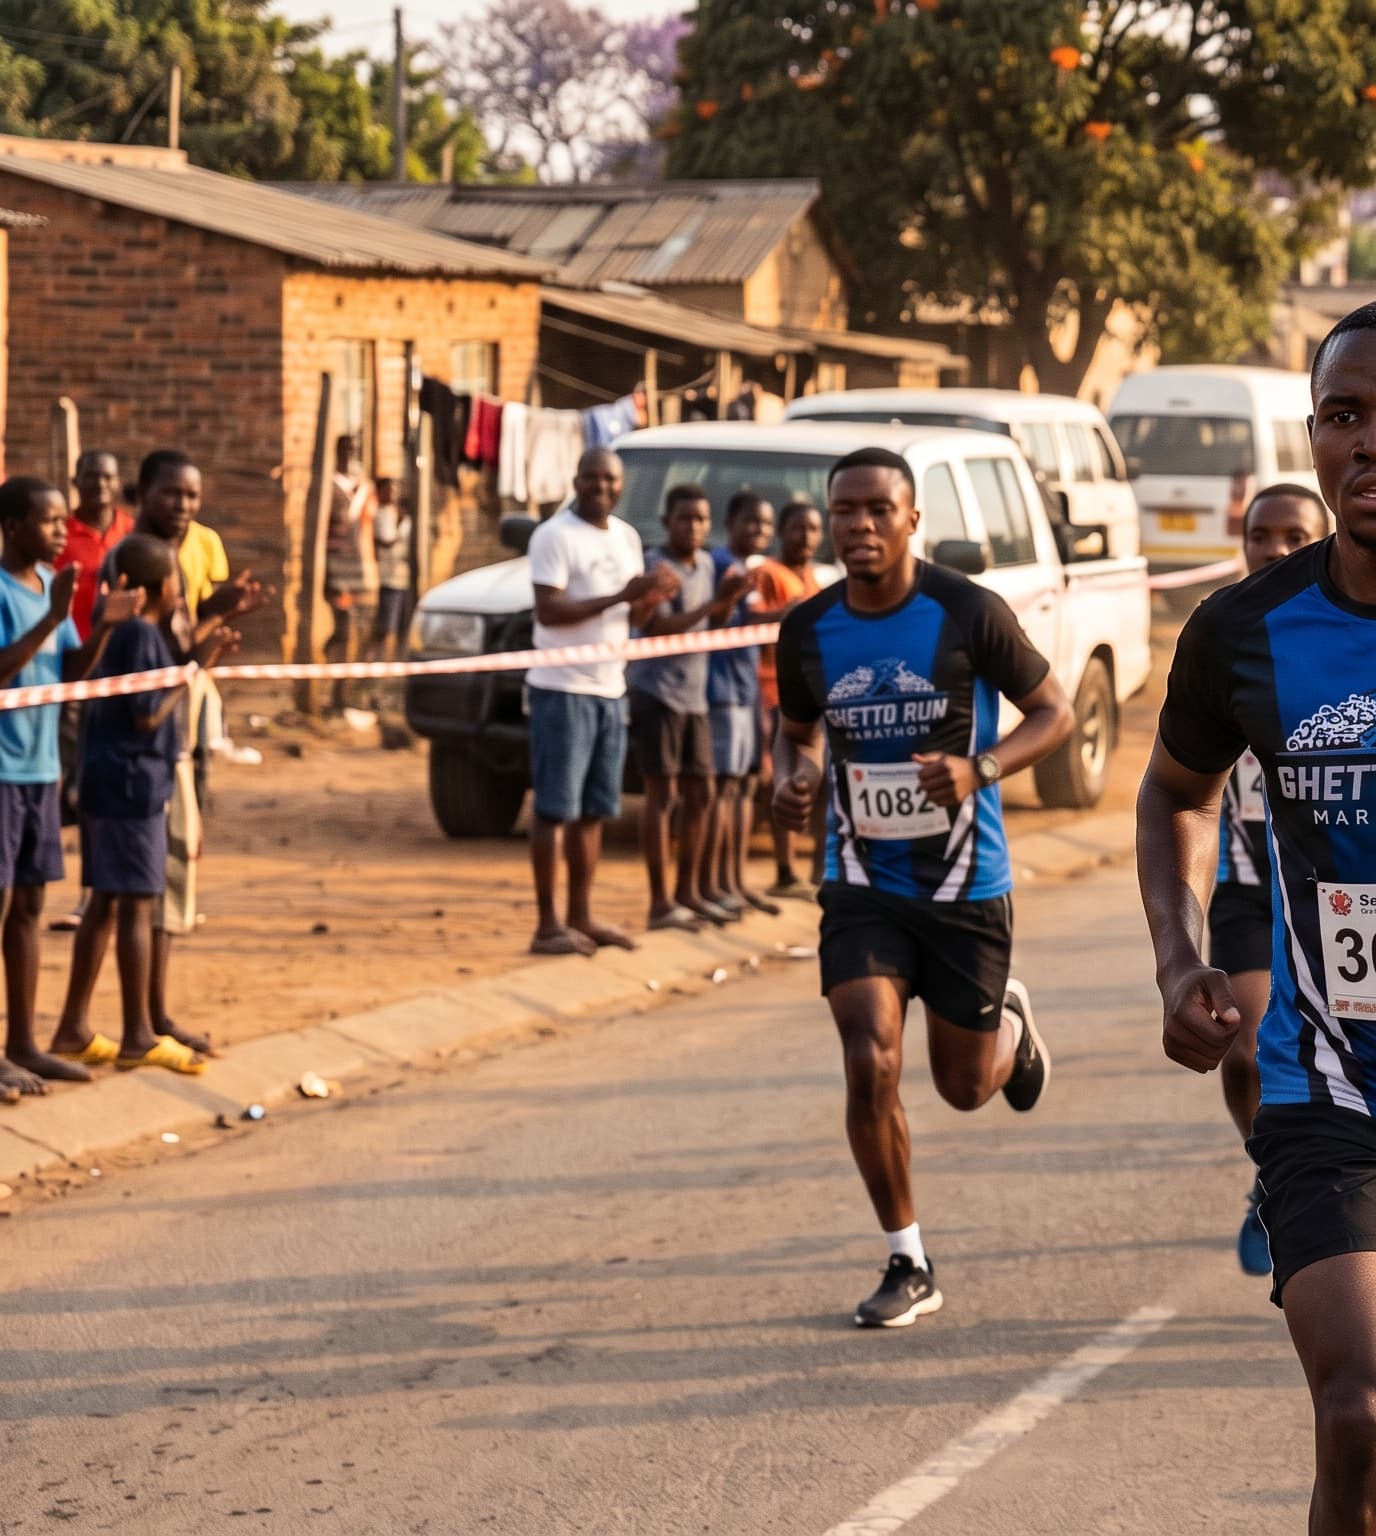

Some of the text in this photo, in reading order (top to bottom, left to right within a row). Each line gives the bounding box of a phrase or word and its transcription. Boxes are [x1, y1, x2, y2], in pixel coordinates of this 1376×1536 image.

[825, 698, 948, 728] GHETTO RUN
[845, 725, 930, 740] MARATHON
[858, 788, 935, 817] 1082
